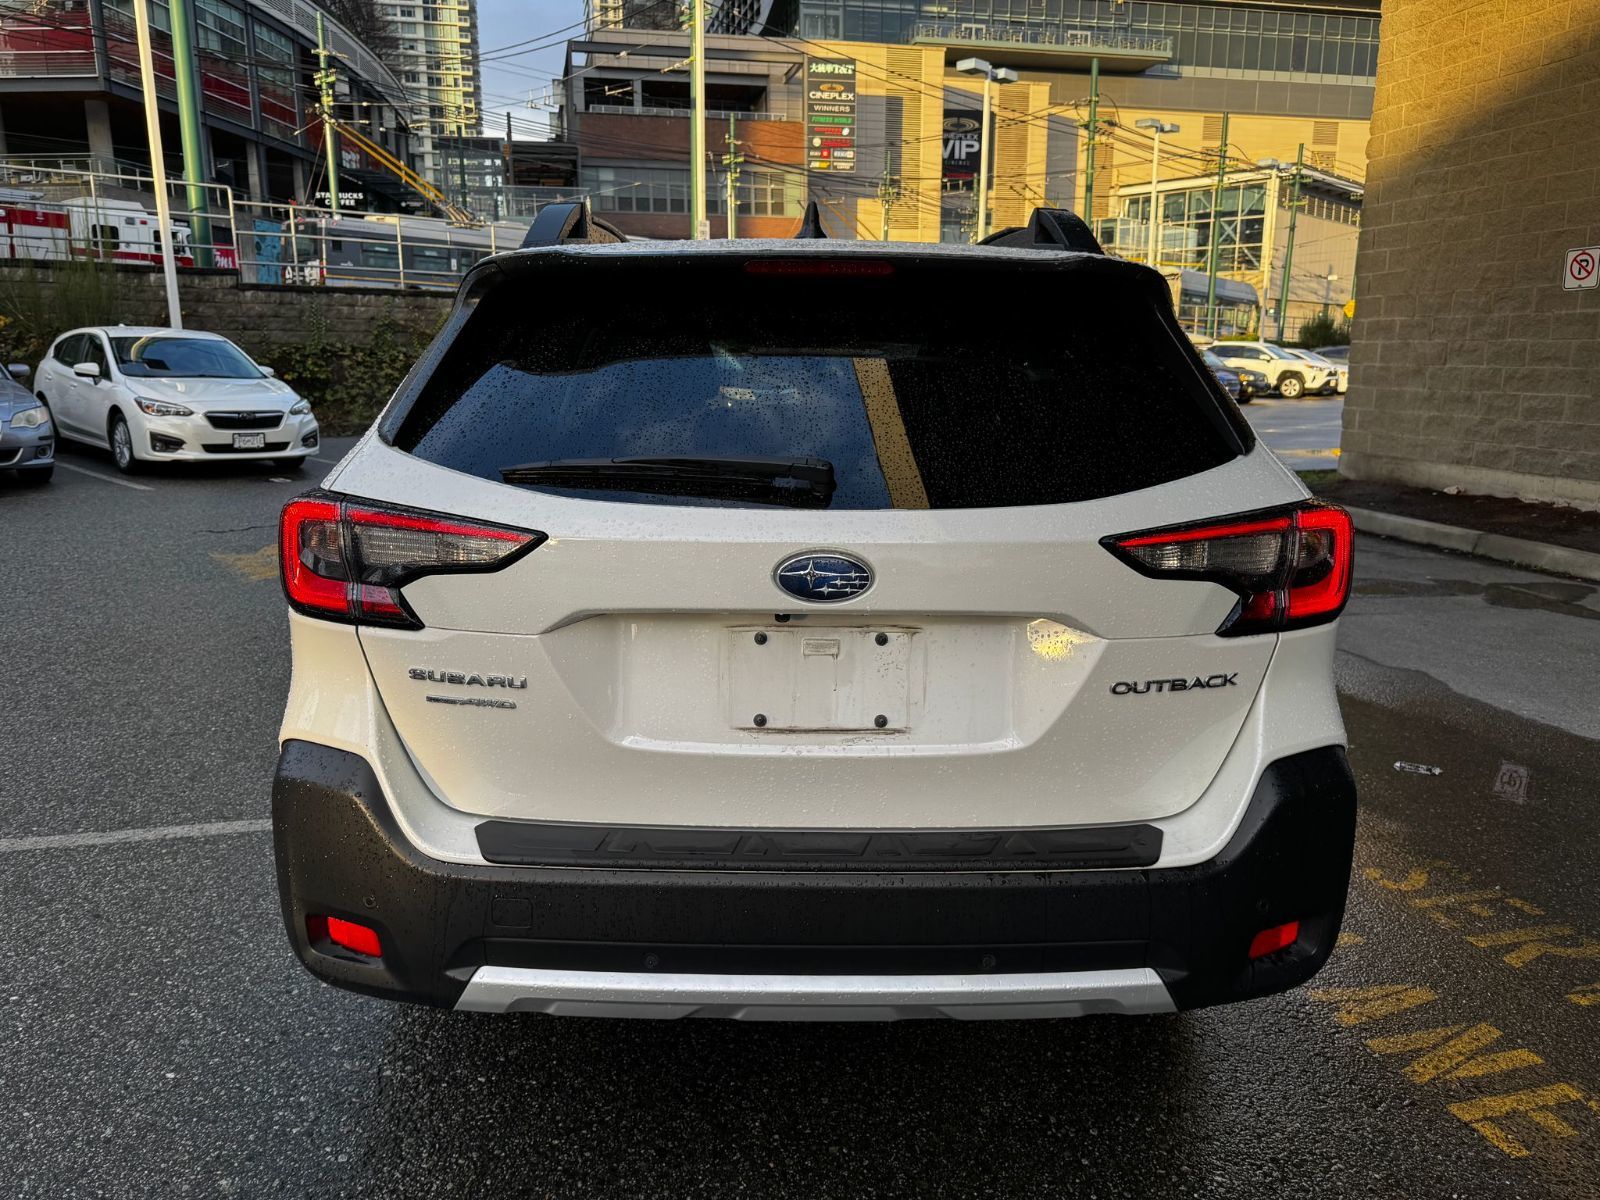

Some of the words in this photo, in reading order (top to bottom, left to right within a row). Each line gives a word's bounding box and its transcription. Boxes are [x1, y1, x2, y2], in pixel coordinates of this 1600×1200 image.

[809, 91, 855, 101] CINEPLEX
[813, 105, 851, 113] WINNERS
[942, 140, 980, 160] VIP
[315, 191, 364, 200] STABUCKS
[408, 667, 528, 689] SUBARU
[1110, 672, 1239, 695] OUTBACK
